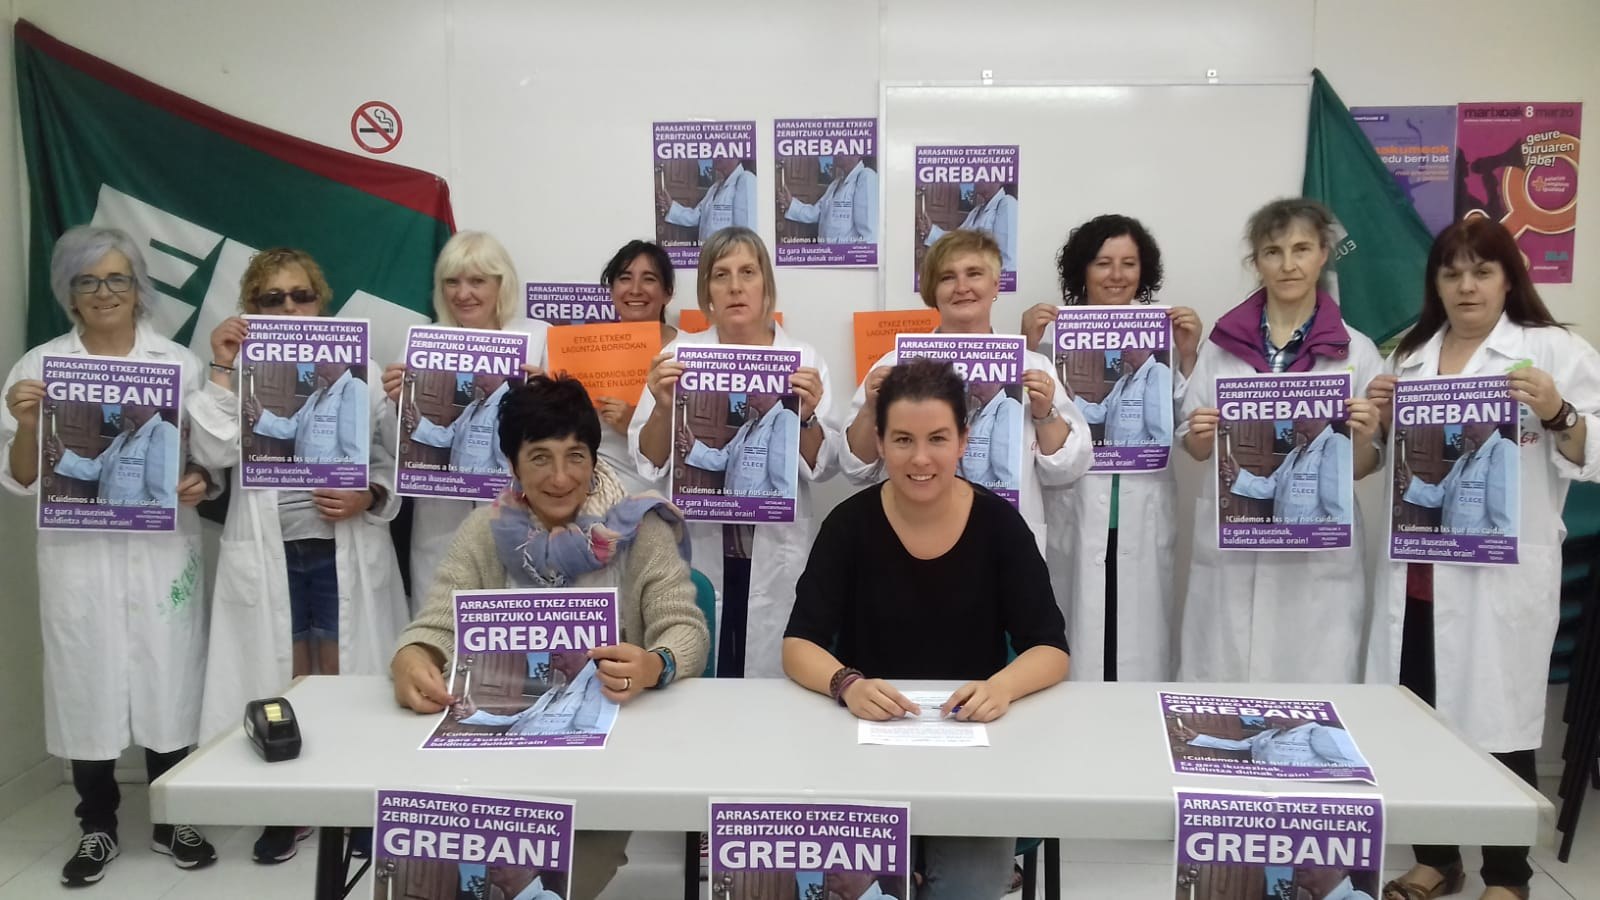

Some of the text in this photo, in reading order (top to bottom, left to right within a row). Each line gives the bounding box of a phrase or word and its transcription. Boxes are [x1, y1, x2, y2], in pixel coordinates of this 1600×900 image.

[1525, 106, 1534, 117] 8
[1527, 131, 1560, 145] geure
[657, 142, 751, 159] GREBAN!
[778, 139, 872, 155] GREBAN!
[1522, 143, 1574, 154] buruaren
[1525, 155, 1556, 166] jabe!
[919, 166, 1013, 182] GREBAN!
[530, 303, 621, 319] GREBAN
[412, 332, 464, 341] ARRASATEKO
[574, 334, 631, 344] ETXEZ ETXEKO
[1059, 332, 1164, 350] GREBAN!
[247, 343, 361, 363] GREBAN!
[411, 341, 465, 350] ZERBITZUKO
[410, 351, 519, 375] GREBAN!
[737, 353, 761, 361] ETXEZ
[46, 361, 107, 371] ARRASATEKO
[953, 363, 1016, 382] BAN!
[46, 371, 109, 380] ZERBITZUKO
[1219, 381, 1278, 389] ARRASATEKO
[1398, 384, 1449, 392] ARRASATEKO
[47, 382, 173, 406] GREBAN!
[1398, 393, 1450, 403] ZERBITZUKO
[1222, 400, 1343, 420] GREBAN!
[1399, 402, 1510, 425] GREBAN!
[460, 599, 608, 609] ARRASATEKO ETXEZ ETXEKO
[461, 613, 533, 622] ZERBITZUKO
[464, 626, 607, 651] GREBAN!
[1169, 705, 1330, 720] GREBAN!
[382, 797, 564, 821] ARRASATEKO ETXEZ ETXEKO
[1183, 799, 1374, 816] ARRASATEKO ETXEZ ETXEKO
[382, 811, 470, 828] ZERBITZUKO
[716, 811, 899, 824] ARRASATEKO ETXEZ ETXEKO
[1184, 815, 1276, 828] ZERBITZUKO
[717, 825, 805, 836] ZERBITZUKO
[384, 828, 560, 867] GREBAN!
[1186, 832, 1371, 866] GREBAN!
[719, 841, 896, 871] GREBAN!
